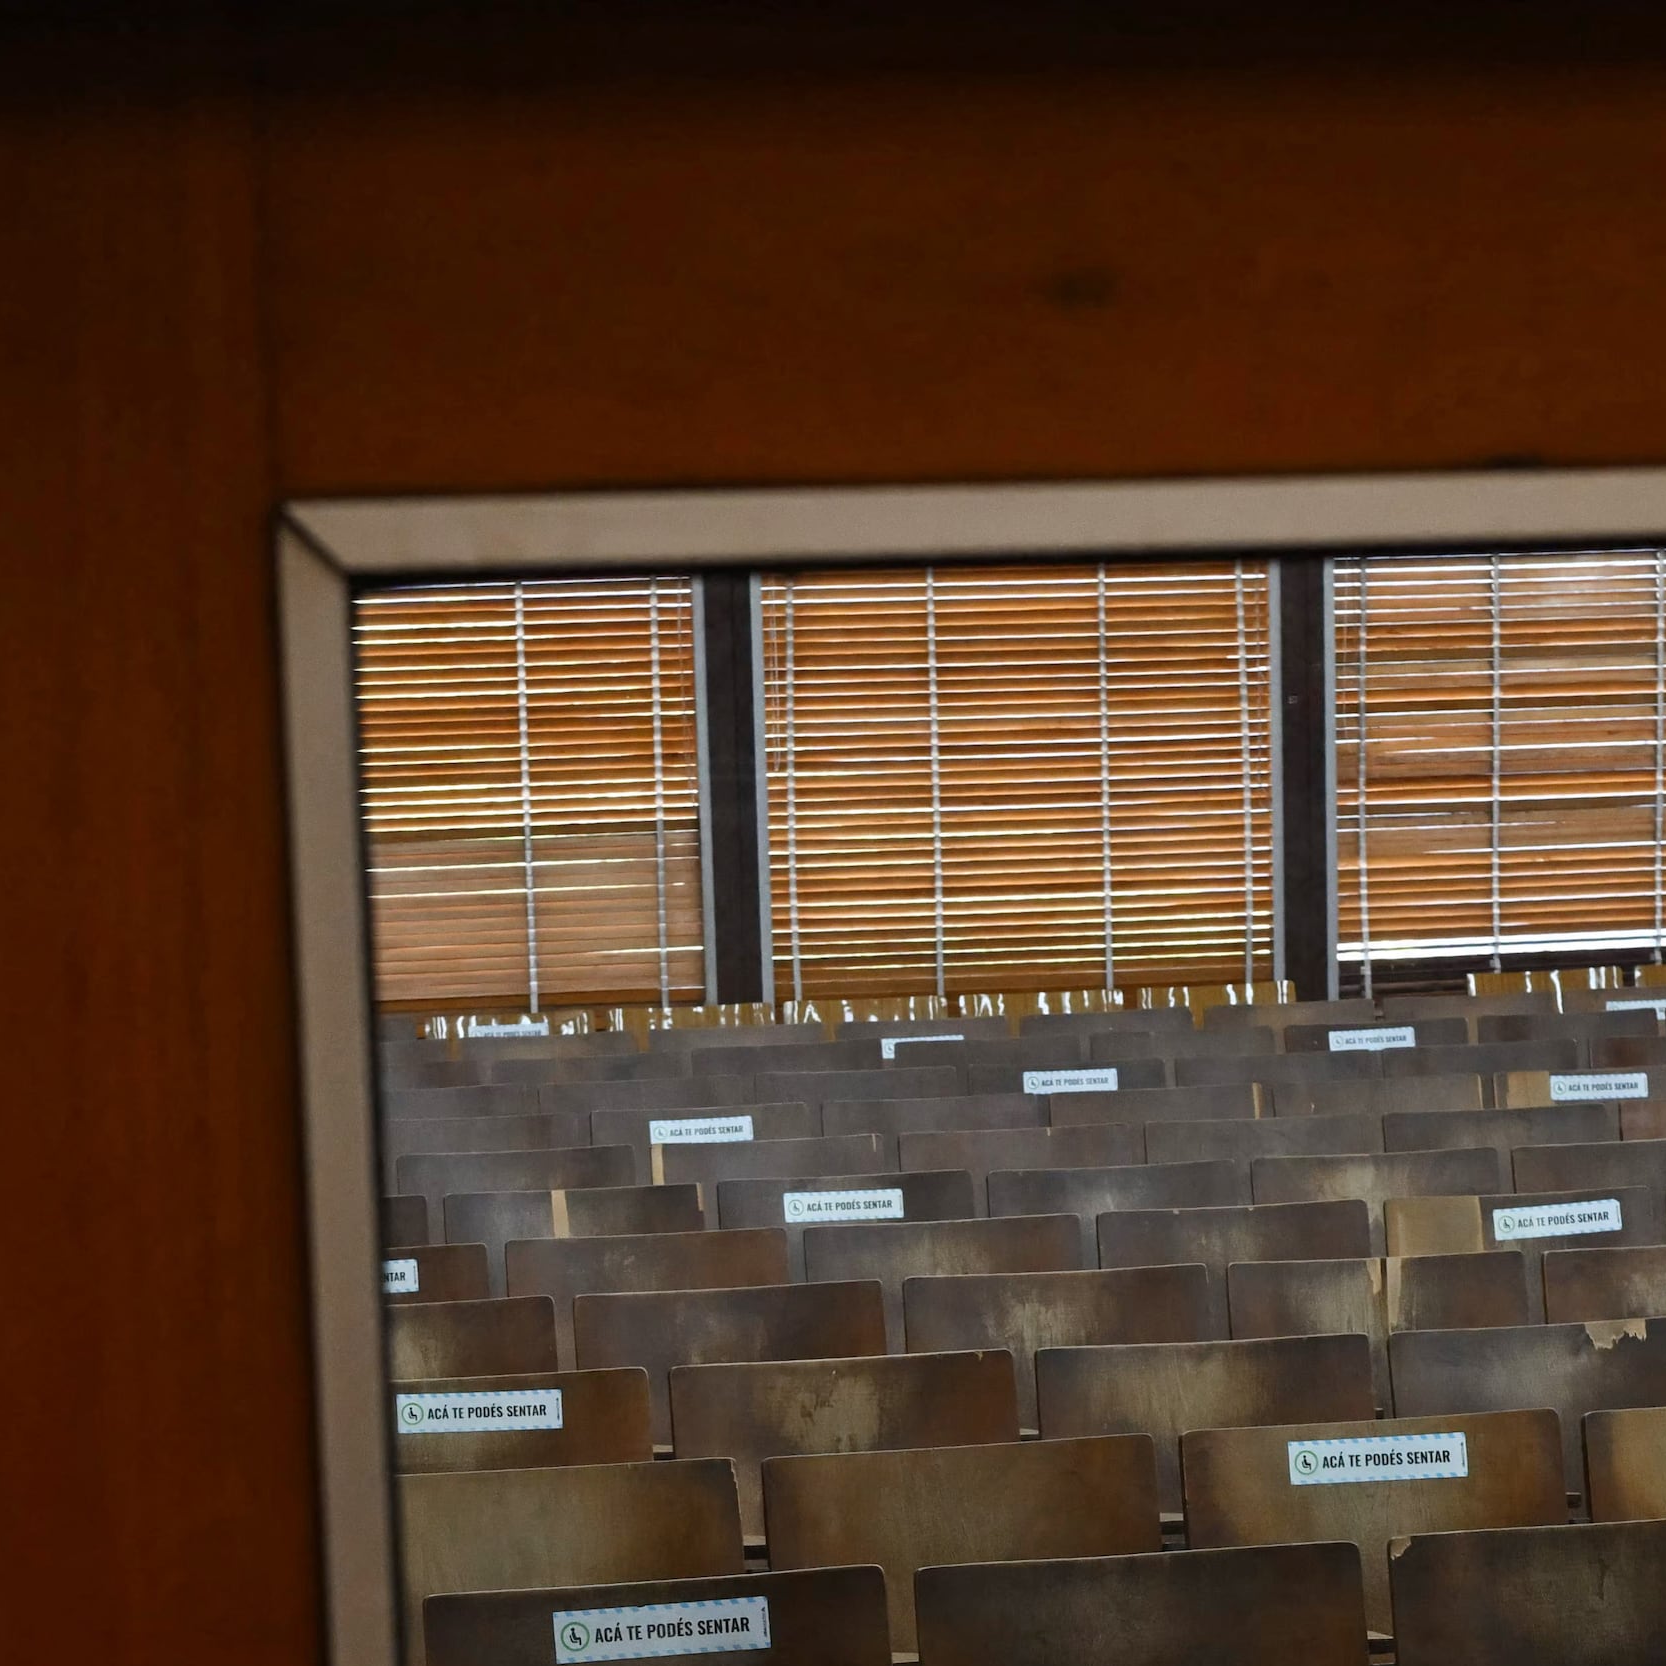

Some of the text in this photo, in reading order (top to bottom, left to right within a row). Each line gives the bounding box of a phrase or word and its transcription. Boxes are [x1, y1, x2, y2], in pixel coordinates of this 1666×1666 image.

[670, 1125, 744, 1136] ACÁ TE PODÉS SENTAR
[807, 1199, 892, 1212] ACÁ TE PODÉS SENTAR
[1518, 1211, 1609, 1228] ACÁ TE PODÉS SENTAR
[427, 1404, 449, 1420] ACÁ
[451, 1407, 464, 1419] TE
[467, 1403, 504, 1419] PODÉS
[506, 1404, 547, 1418] SENTAR
[1322, 1451, 1345, 1469] ACÁ
[1348, 1454, 1362, 1468] TE
[1365, 1449, 1404, 1467] PODÉS
[1406, 1450, 1451, 1465] SENTAR
[595, 1622, 623, 1644] ACÁ
[626, 1625, 643, 1641] TE
[646, 1617, 694, 1640] PODÉS
[697, 1616, 750, 1636] SENTAR
